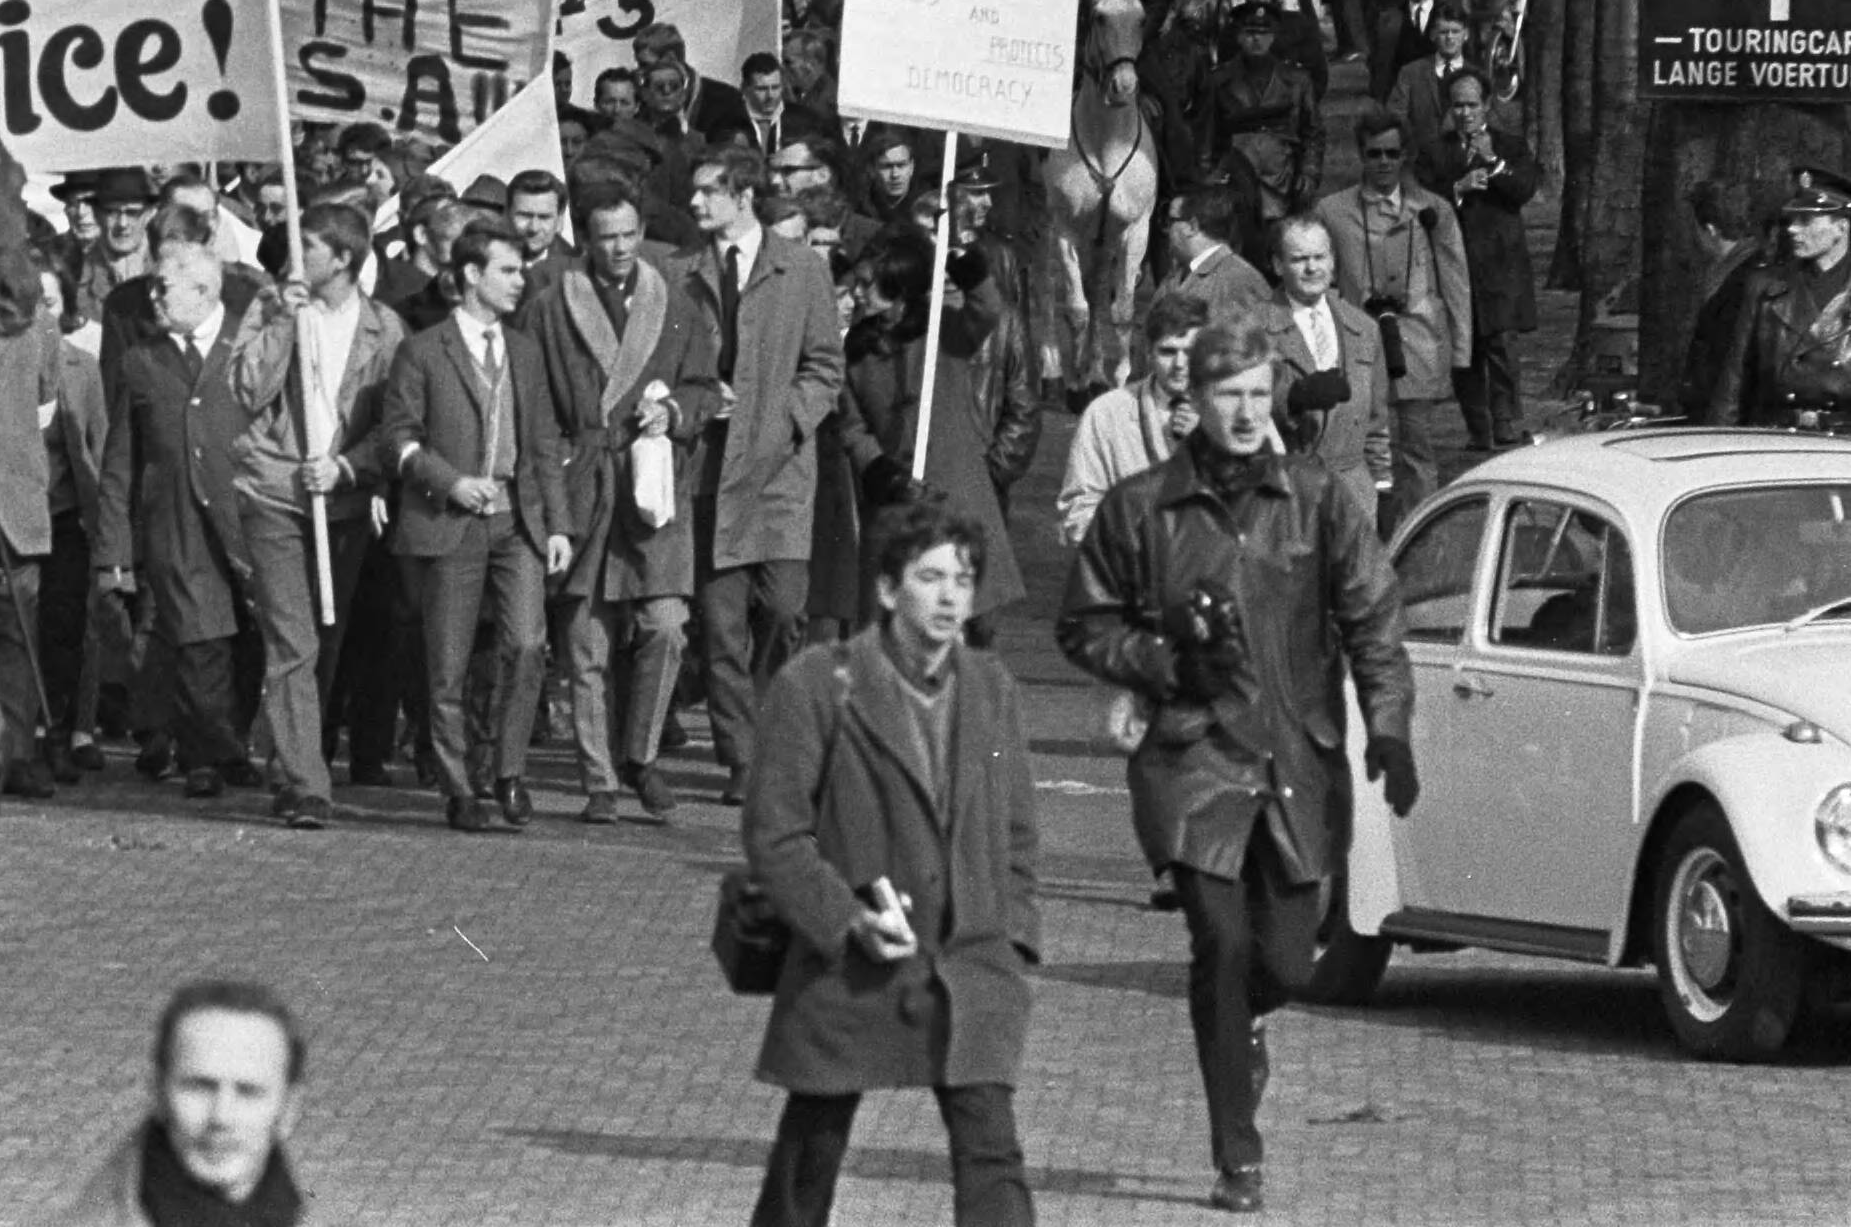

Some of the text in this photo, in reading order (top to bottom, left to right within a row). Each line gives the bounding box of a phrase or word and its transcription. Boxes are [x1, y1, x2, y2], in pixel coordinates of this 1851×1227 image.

[969, 6, 1000, 25] AND
[908, 65, 1034, 109] DEMOCRACY
[1653, 60, 1738, 87] LANGE
